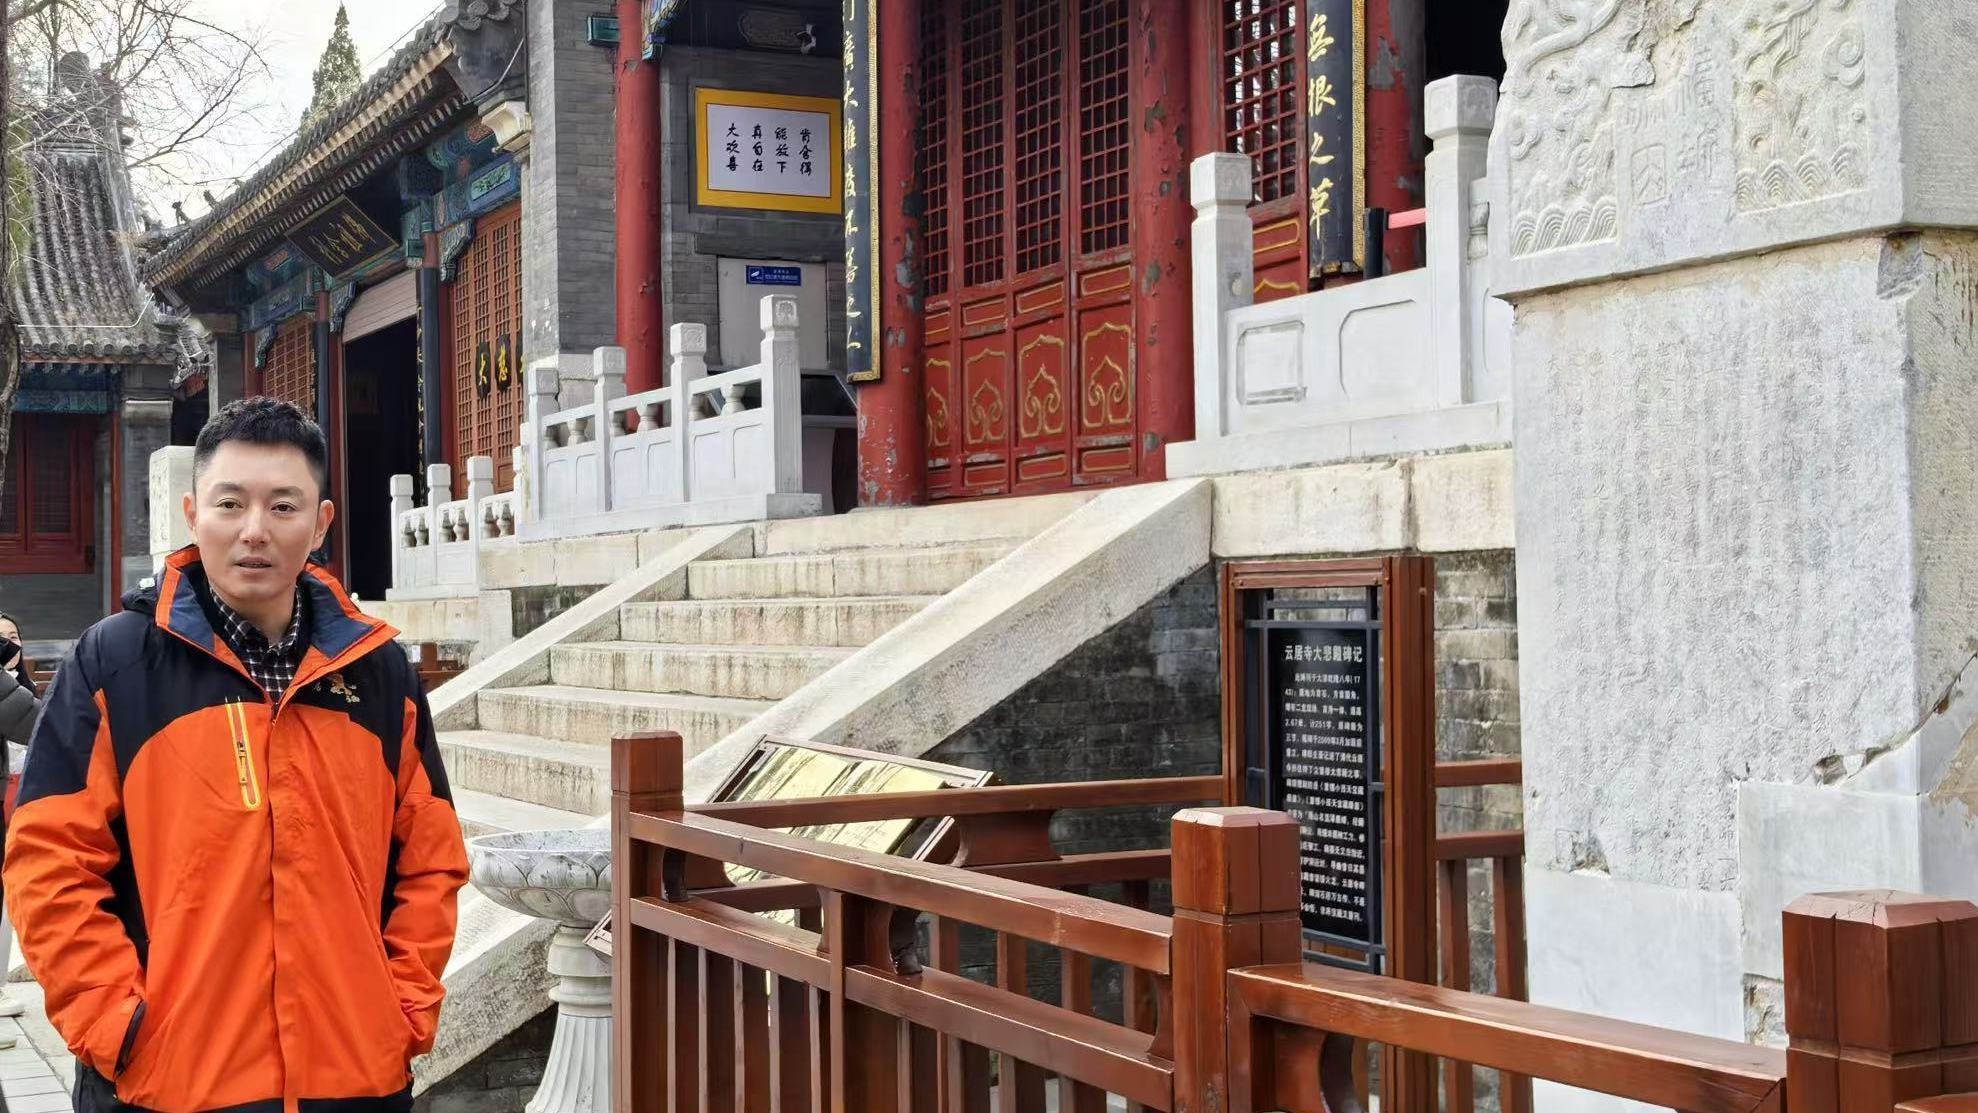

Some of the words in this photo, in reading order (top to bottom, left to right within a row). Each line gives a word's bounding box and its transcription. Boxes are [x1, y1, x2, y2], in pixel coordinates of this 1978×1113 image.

[752, 123, 764, 172] 真自在
[774, 127, 789, 174] 能放下
[1284, 644, 1363, 663] 云居寺大悲殿碑记
